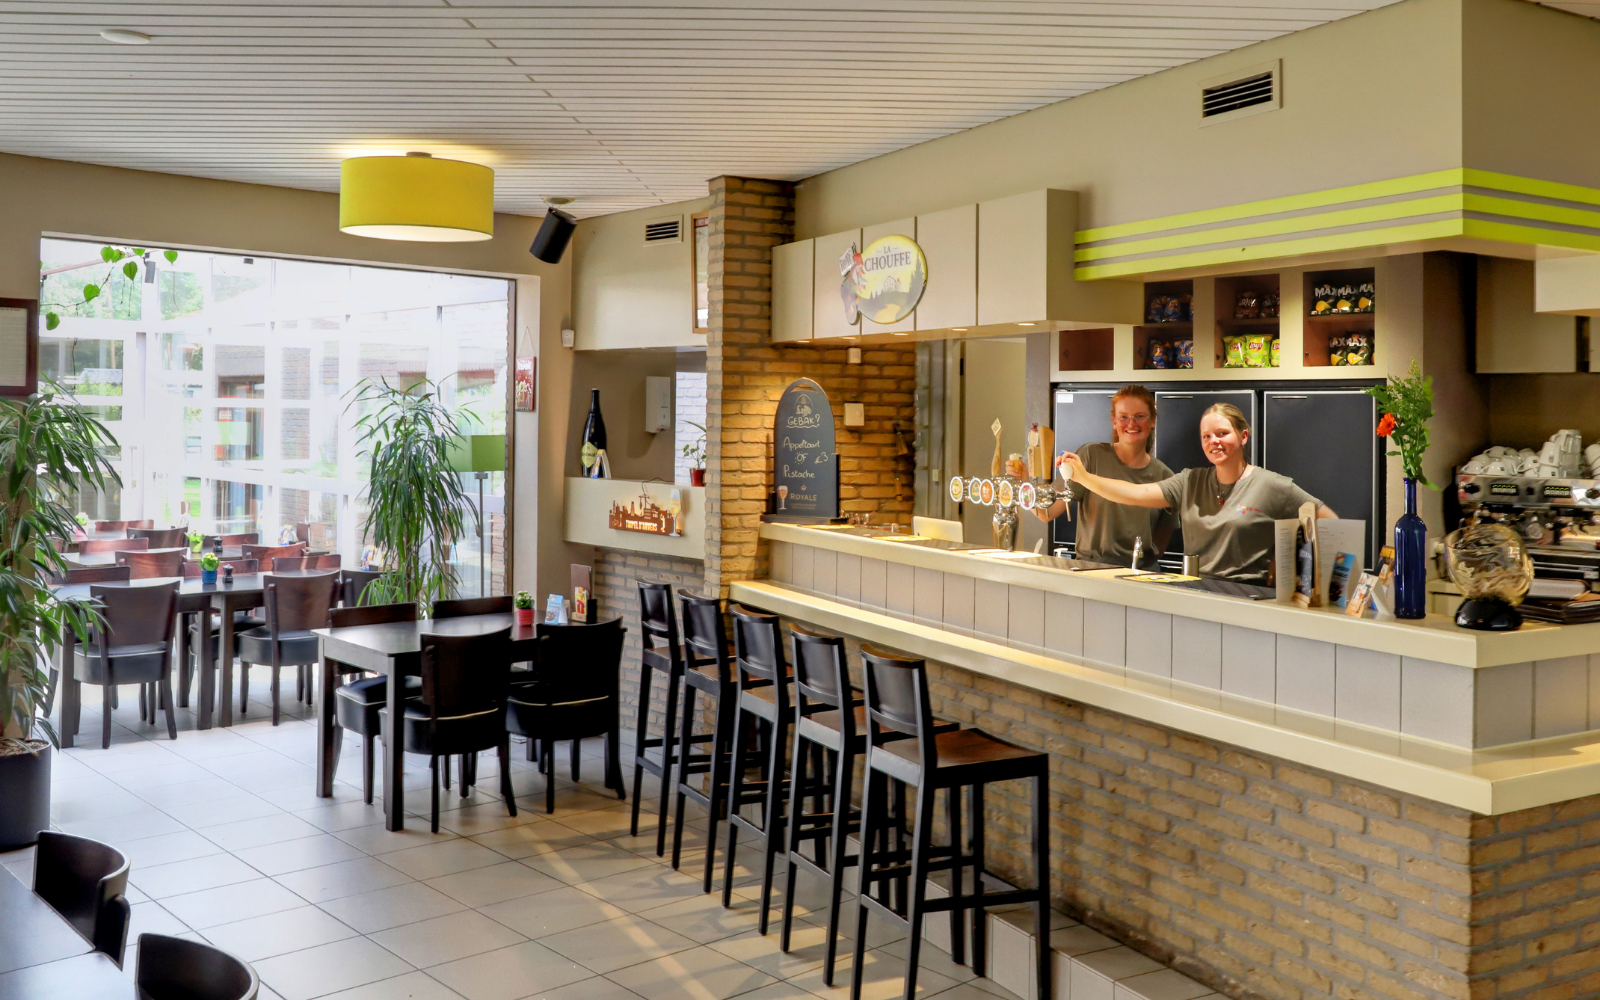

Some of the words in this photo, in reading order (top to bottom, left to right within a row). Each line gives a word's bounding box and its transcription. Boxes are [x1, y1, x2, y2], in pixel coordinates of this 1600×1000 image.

[883, 246, 891, 254] LA
[864, 251, 912, 272] CHOUFFE
[1359, 283, 1375, 293] MA
[783, 464, 815, 478] Pistache
[790, 492, 817, 501] ROYALE
